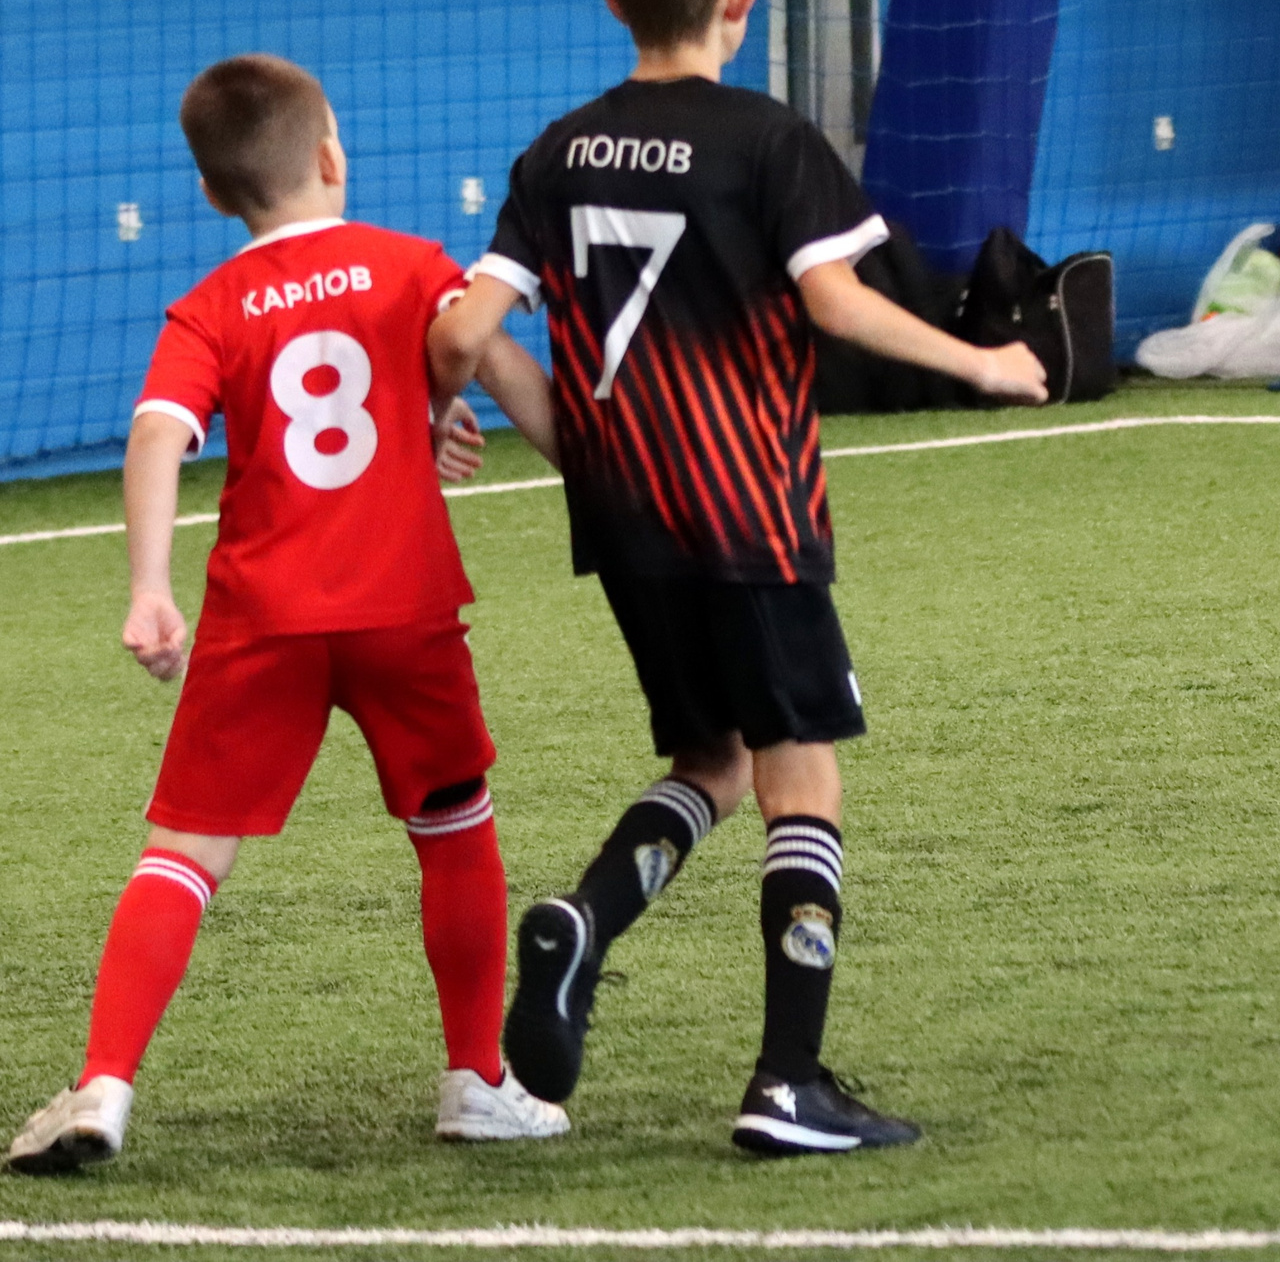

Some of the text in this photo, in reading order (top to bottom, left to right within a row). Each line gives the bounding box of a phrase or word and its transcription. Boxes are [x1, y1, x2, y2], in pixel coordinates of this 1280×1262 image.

[566, 134, 693, 174] ПОПОВ
[241, 265, 373, 321] КАРПОВ
[569, 203, 687, 400] 7
[269, 329, 378, 491] 8
